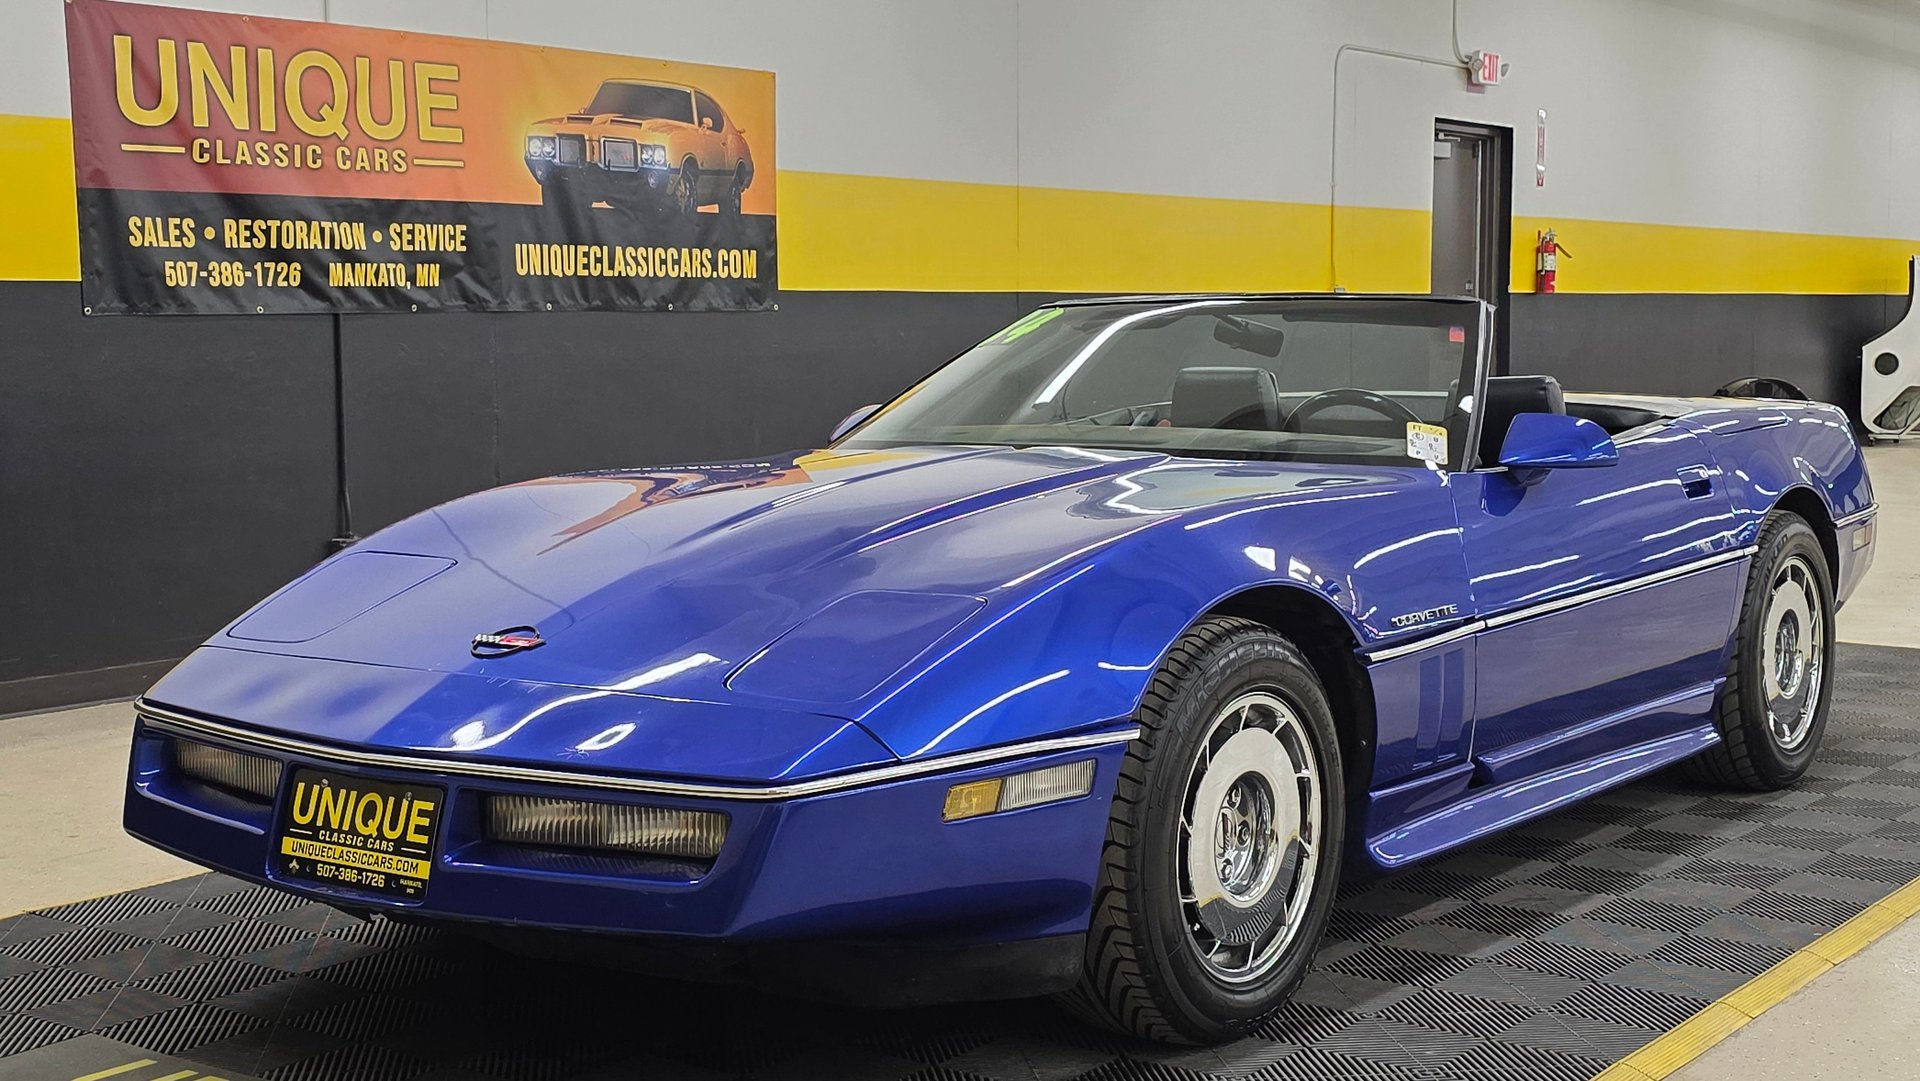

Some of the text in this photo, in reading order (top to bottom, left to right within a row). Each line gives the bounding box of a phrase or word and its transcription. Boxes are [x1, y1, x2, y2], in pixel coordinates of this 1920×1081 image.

[1483, 53, 1499, 82] EXIT
[113, 34, 463, 141] UNIQUE
[192, 138, 409, 173] CLASSIC CARS
[128, 216, 467, 252] SALES RESTORATION SERVICE
[164, 259, 441, 292] 507-386-1726 MANKATO, MN
[515, 243, 757, 279] UNIQUECLASSICCARS.COM
[1396, 604, 1458, 626] CORVETTE
[293, 782, 434, 844] UNIQUE
[291, 840, 419, 875] UNIQUECLASSICCARS.COM
[318, 830, 395, 852] CLASSIC CARS
[316, 863, 386, 888] 507-386-1726
